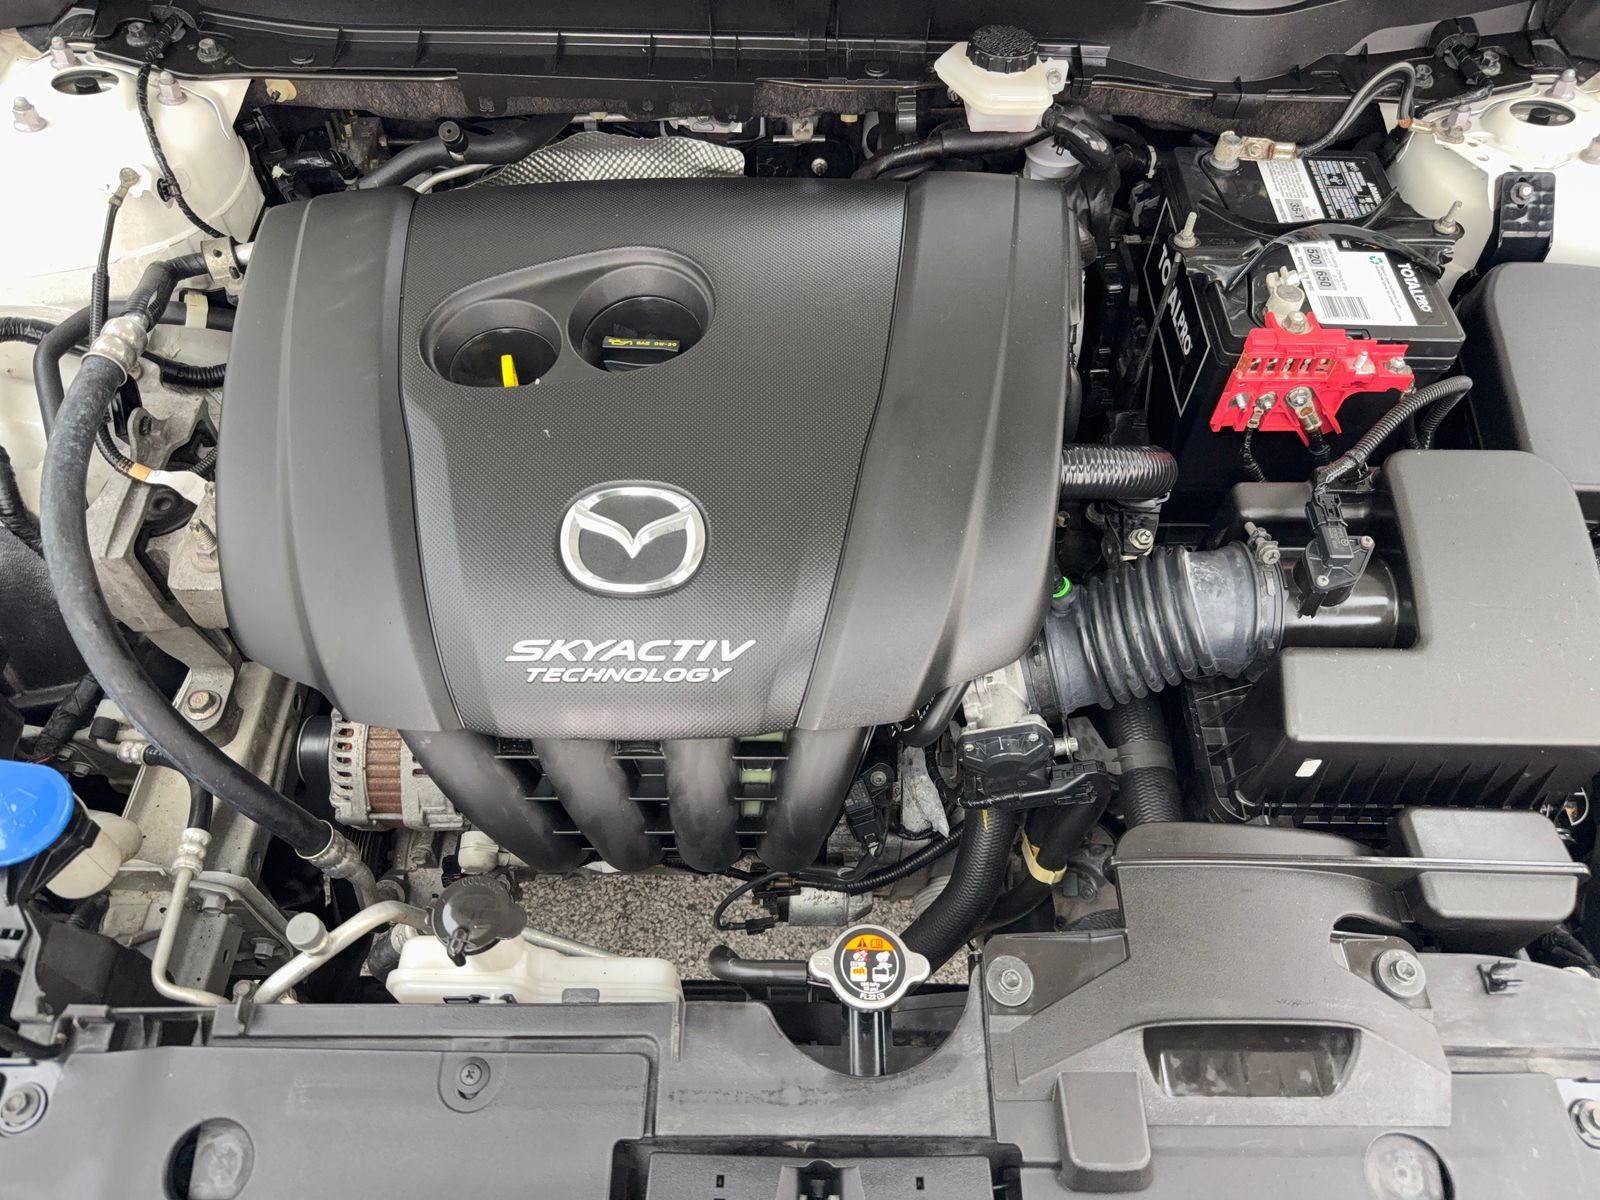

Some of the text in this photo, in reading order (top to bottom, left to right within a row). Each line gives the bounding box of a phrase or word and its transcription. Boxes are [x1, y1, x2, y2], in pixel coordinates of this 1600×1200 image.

[1289, 202, 1305, 219] 35-T
[1306, 248, 1332, 287] 520 650
[1158, 243, 1193, 356] TOALPRO
[1397, 263, 1432, 313] TOTALPRO
[504, 639, 757, 662] SKYACTIV
[526, 667, 733, 683] TECHNOLOGY
